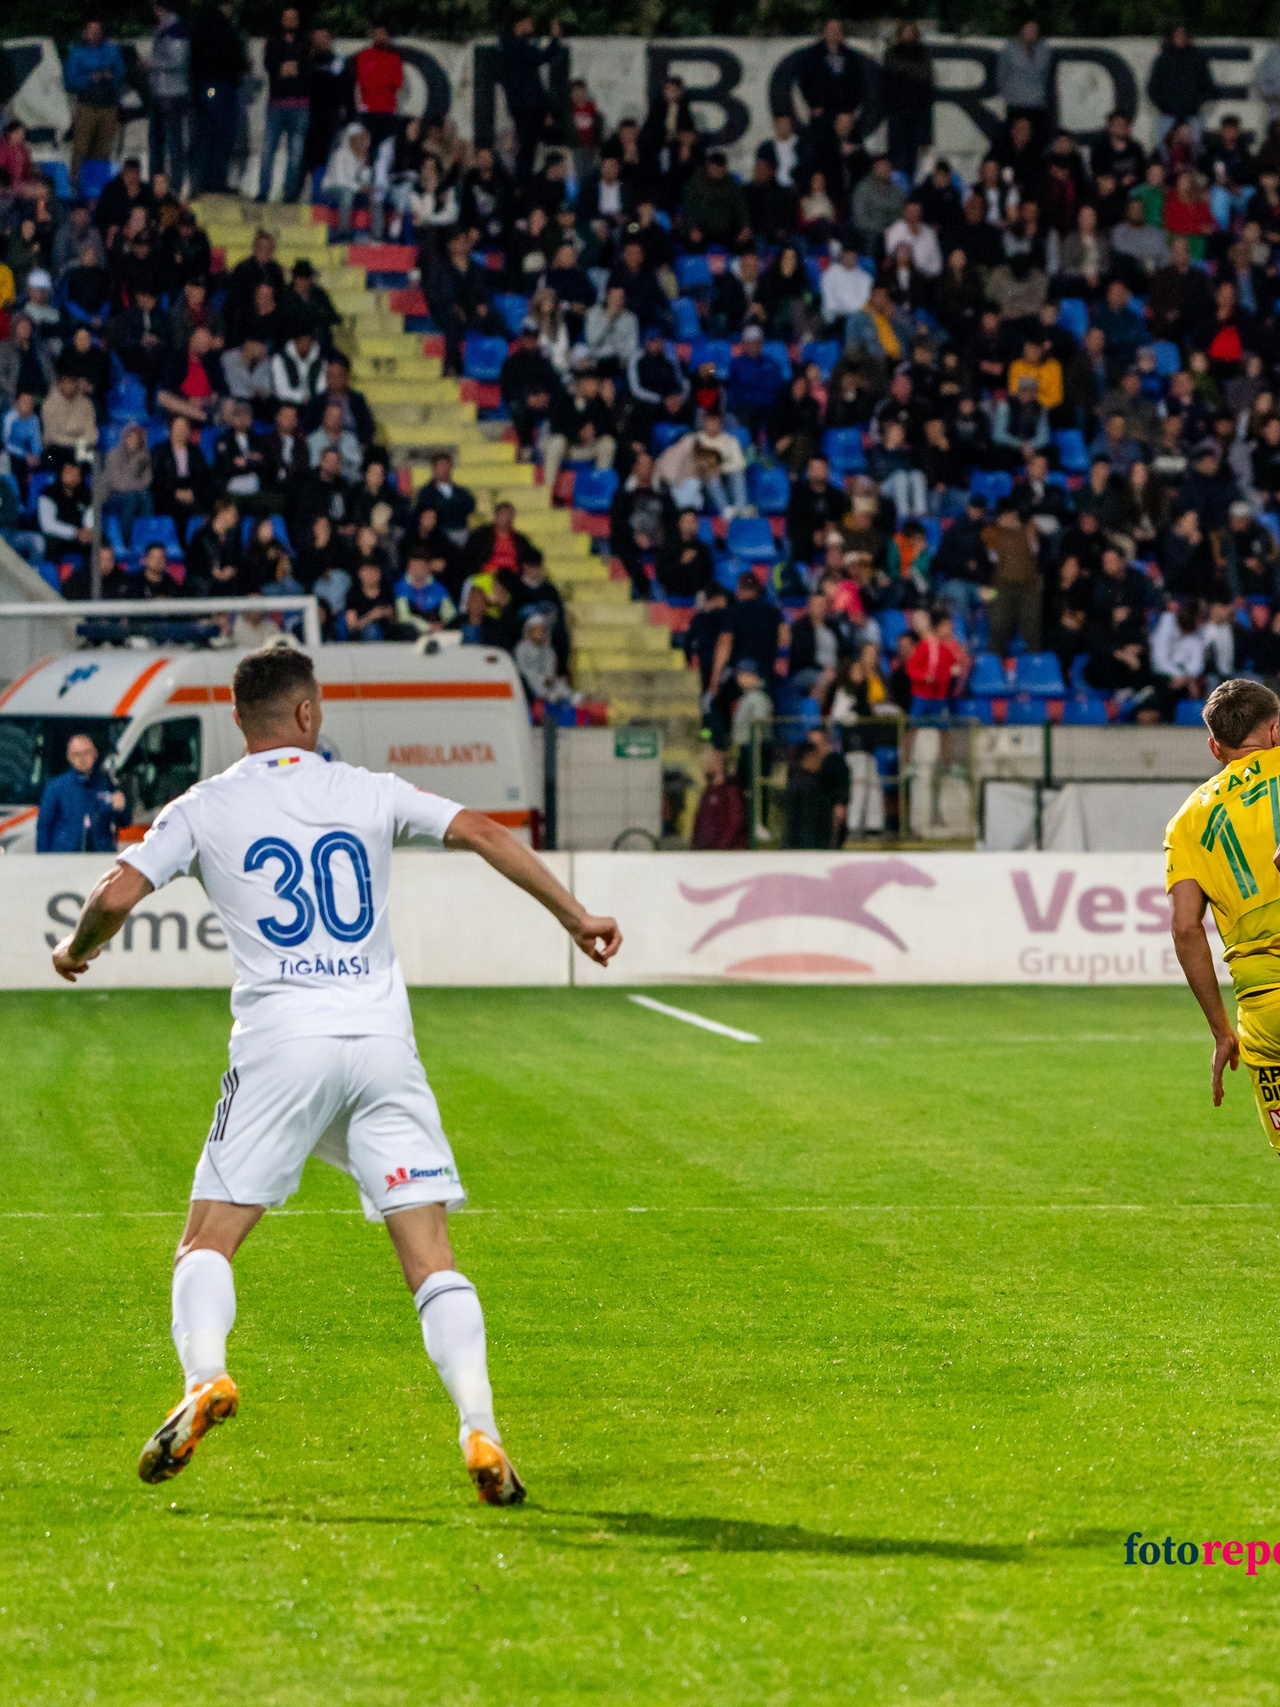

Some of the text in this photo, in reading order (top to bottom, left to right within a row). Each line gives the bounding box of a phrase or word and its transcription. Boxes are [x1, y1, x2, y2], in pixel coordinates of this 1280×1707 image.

[244, 831, 374, 947] 30
[1010, 870, 1219, 934] Ves
[45, 891, 229, 951] Sme
[1018, 946, 1147, 983] Grupul
[410, 1168, 442, 1179] Smart
